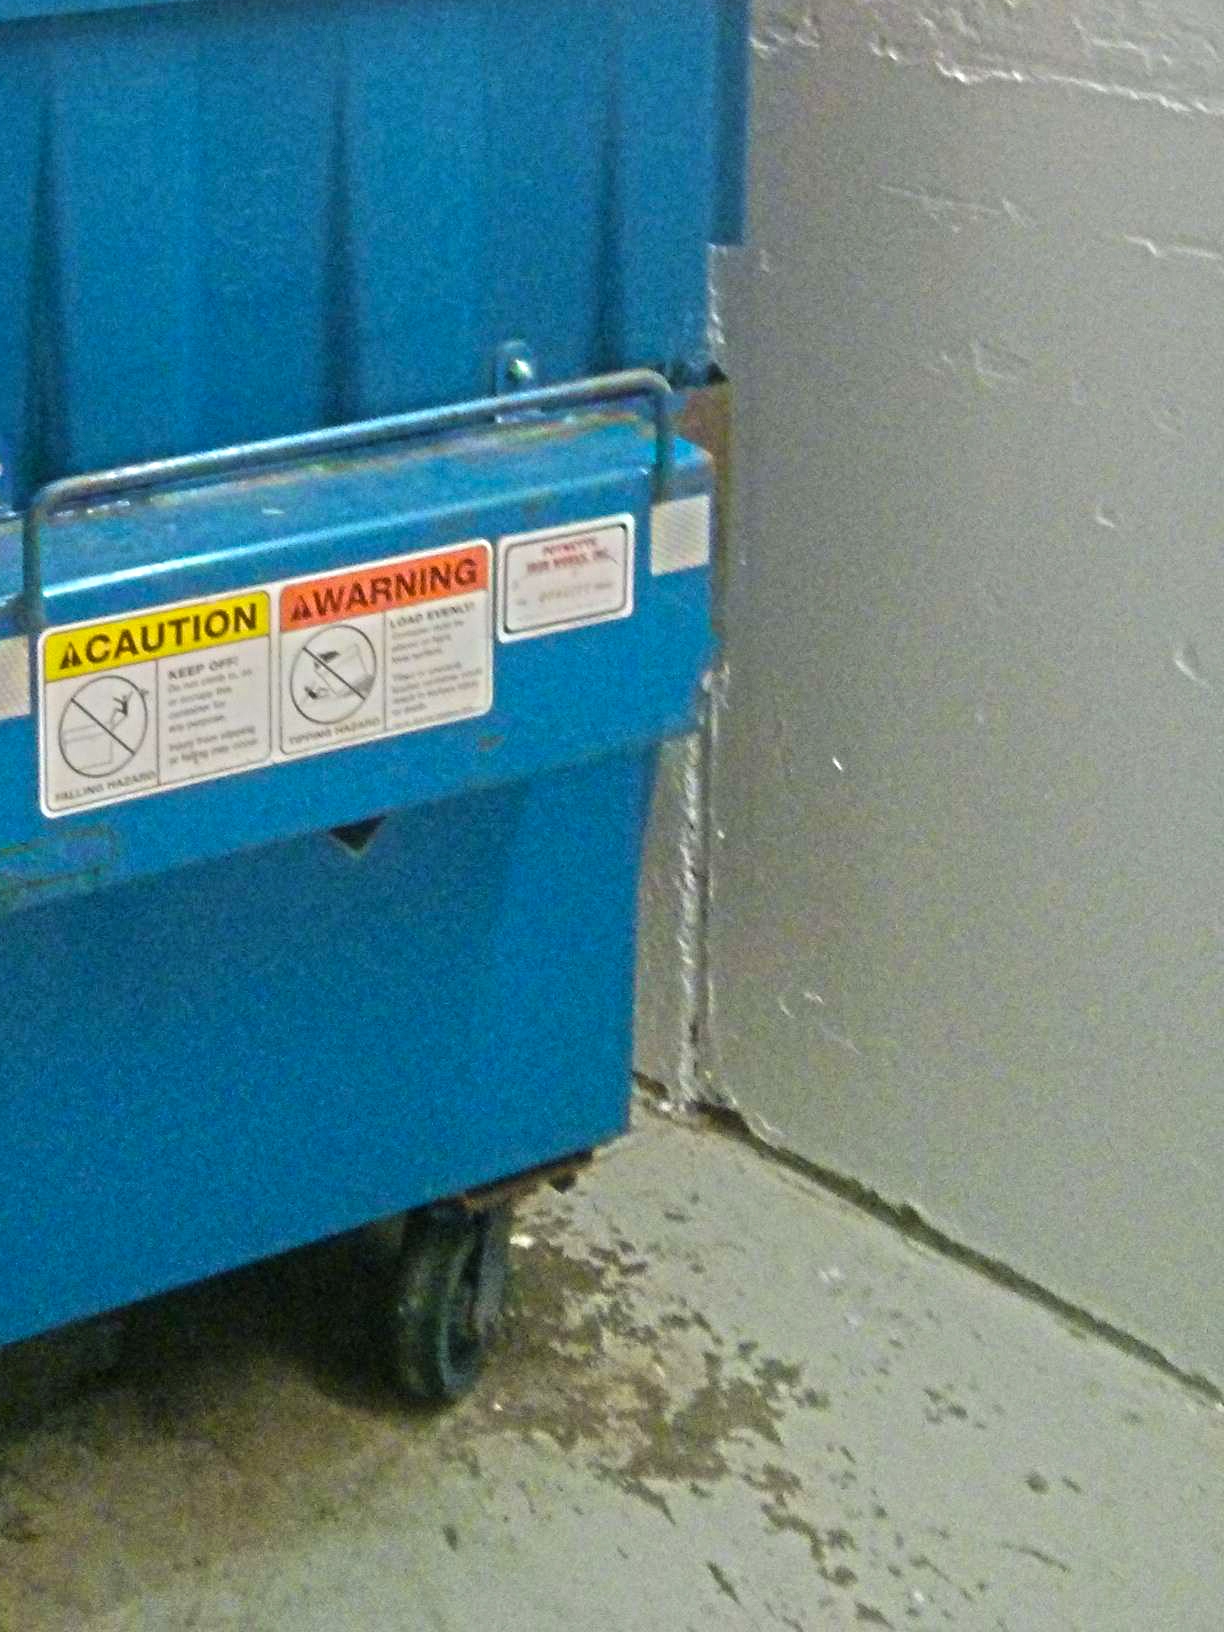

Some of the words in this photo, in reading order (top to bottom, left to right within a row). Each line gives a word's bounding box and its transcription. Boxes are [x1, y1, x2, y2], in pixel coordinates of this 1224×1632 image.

[314, 558, 478, 618] WARNING
[85, 602, 258, 662] CAUTION
[168, 663, 205, 680] KEEP
